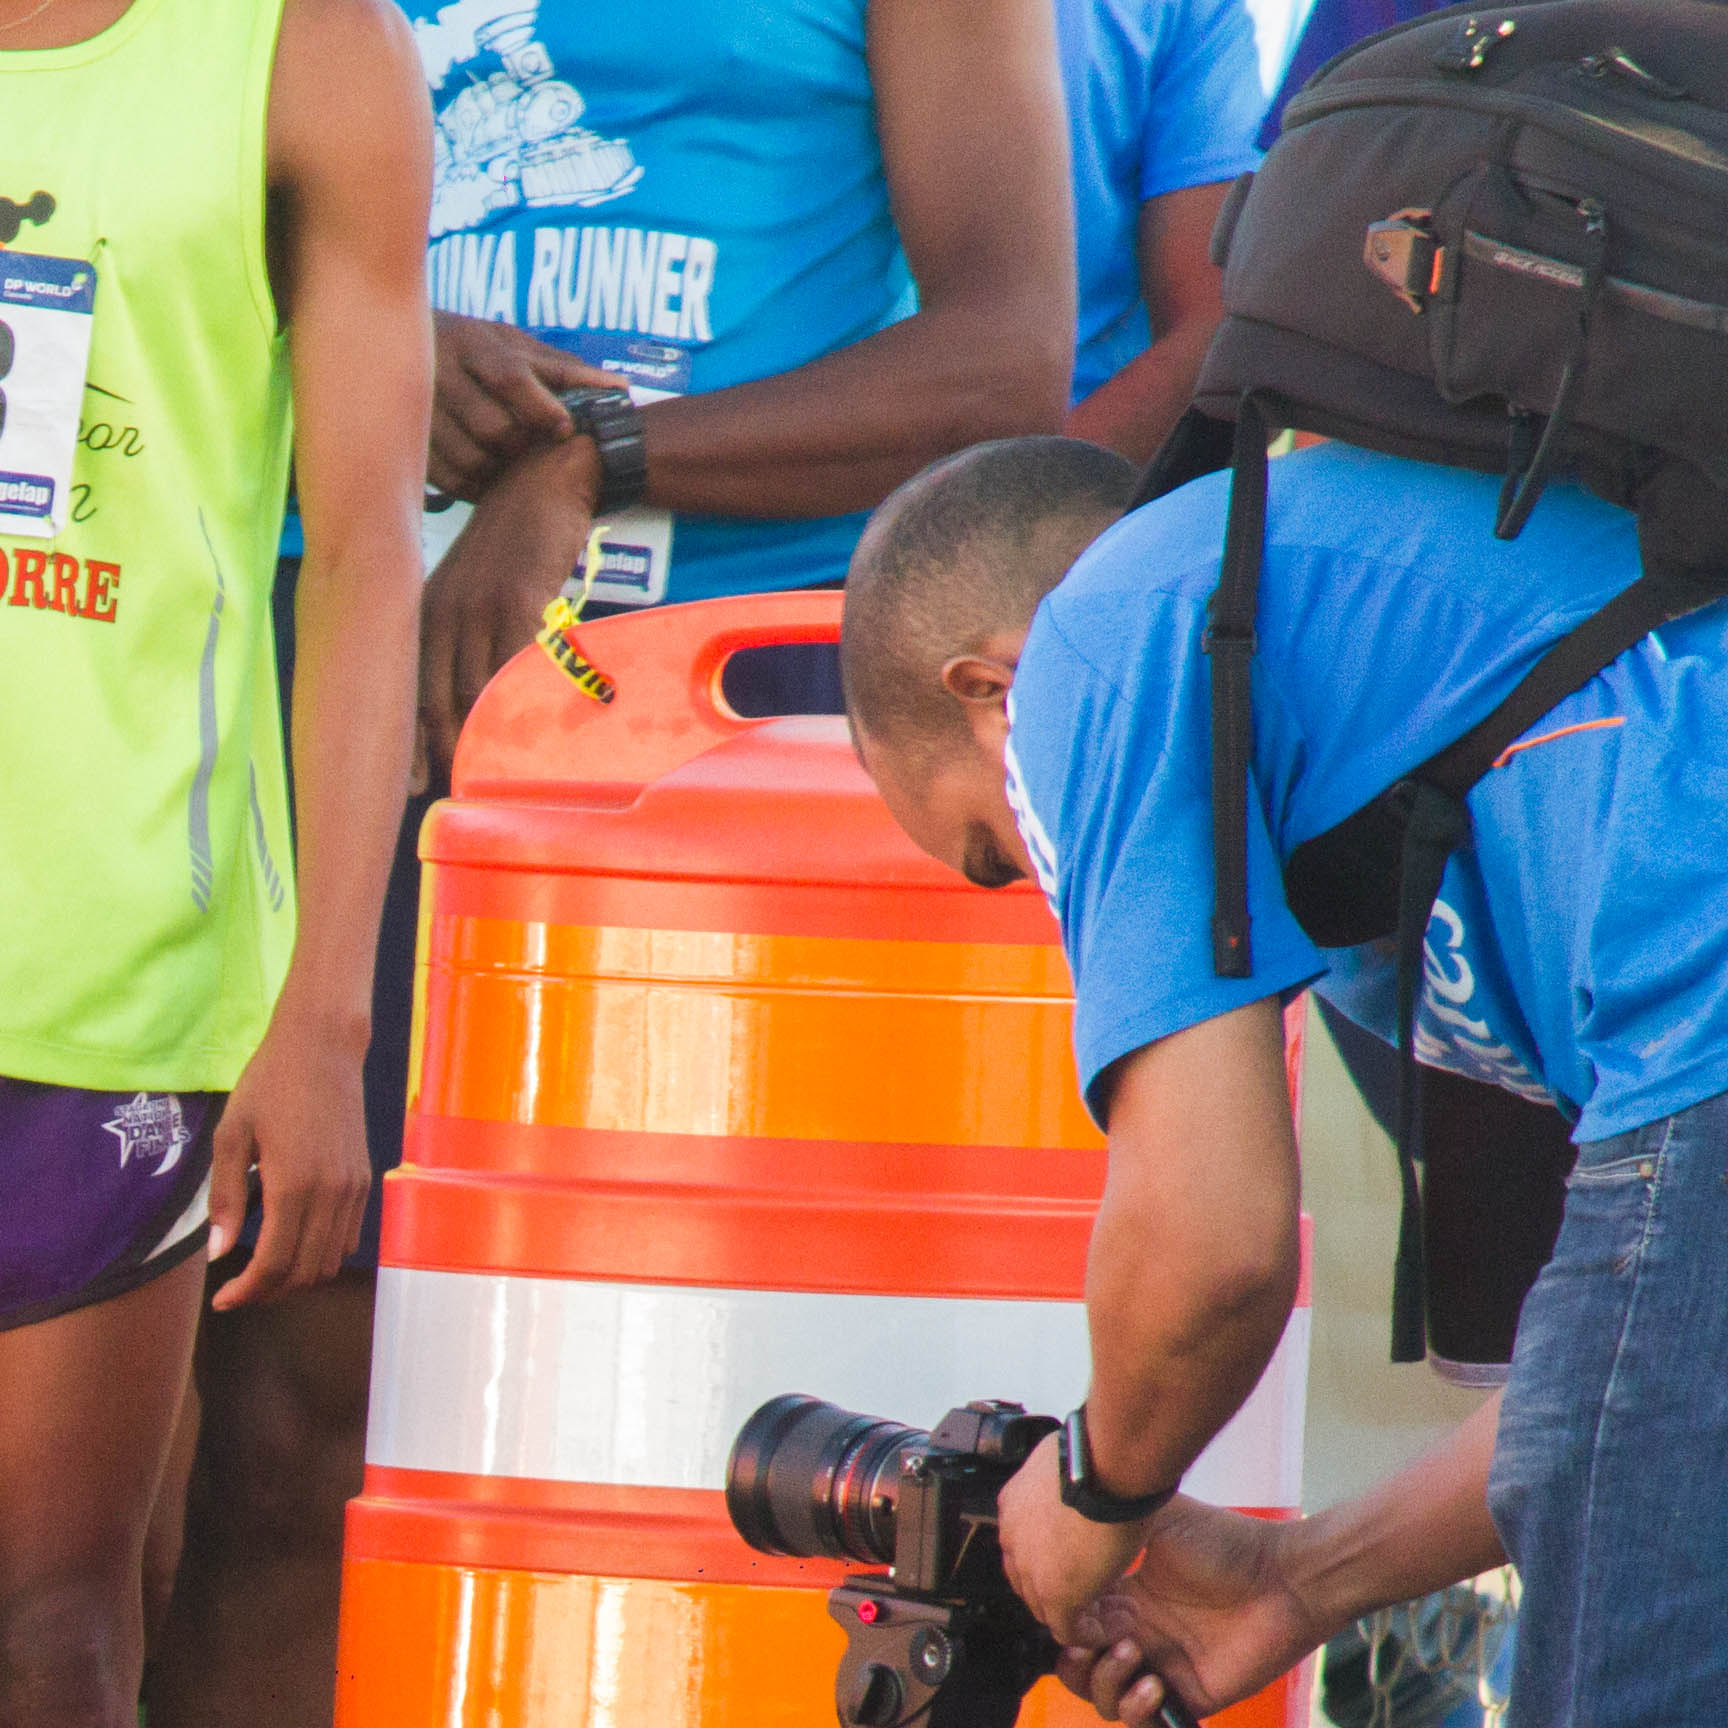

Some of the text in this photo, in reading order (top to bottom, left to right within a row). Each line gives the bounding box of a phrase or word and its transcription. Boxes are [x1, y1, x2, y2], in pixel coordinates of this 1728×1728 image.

[4, 278, 23, 292] DP
[24, 281, 74, 298] WORLD
[527, 226, 718, 342] RUNNER
